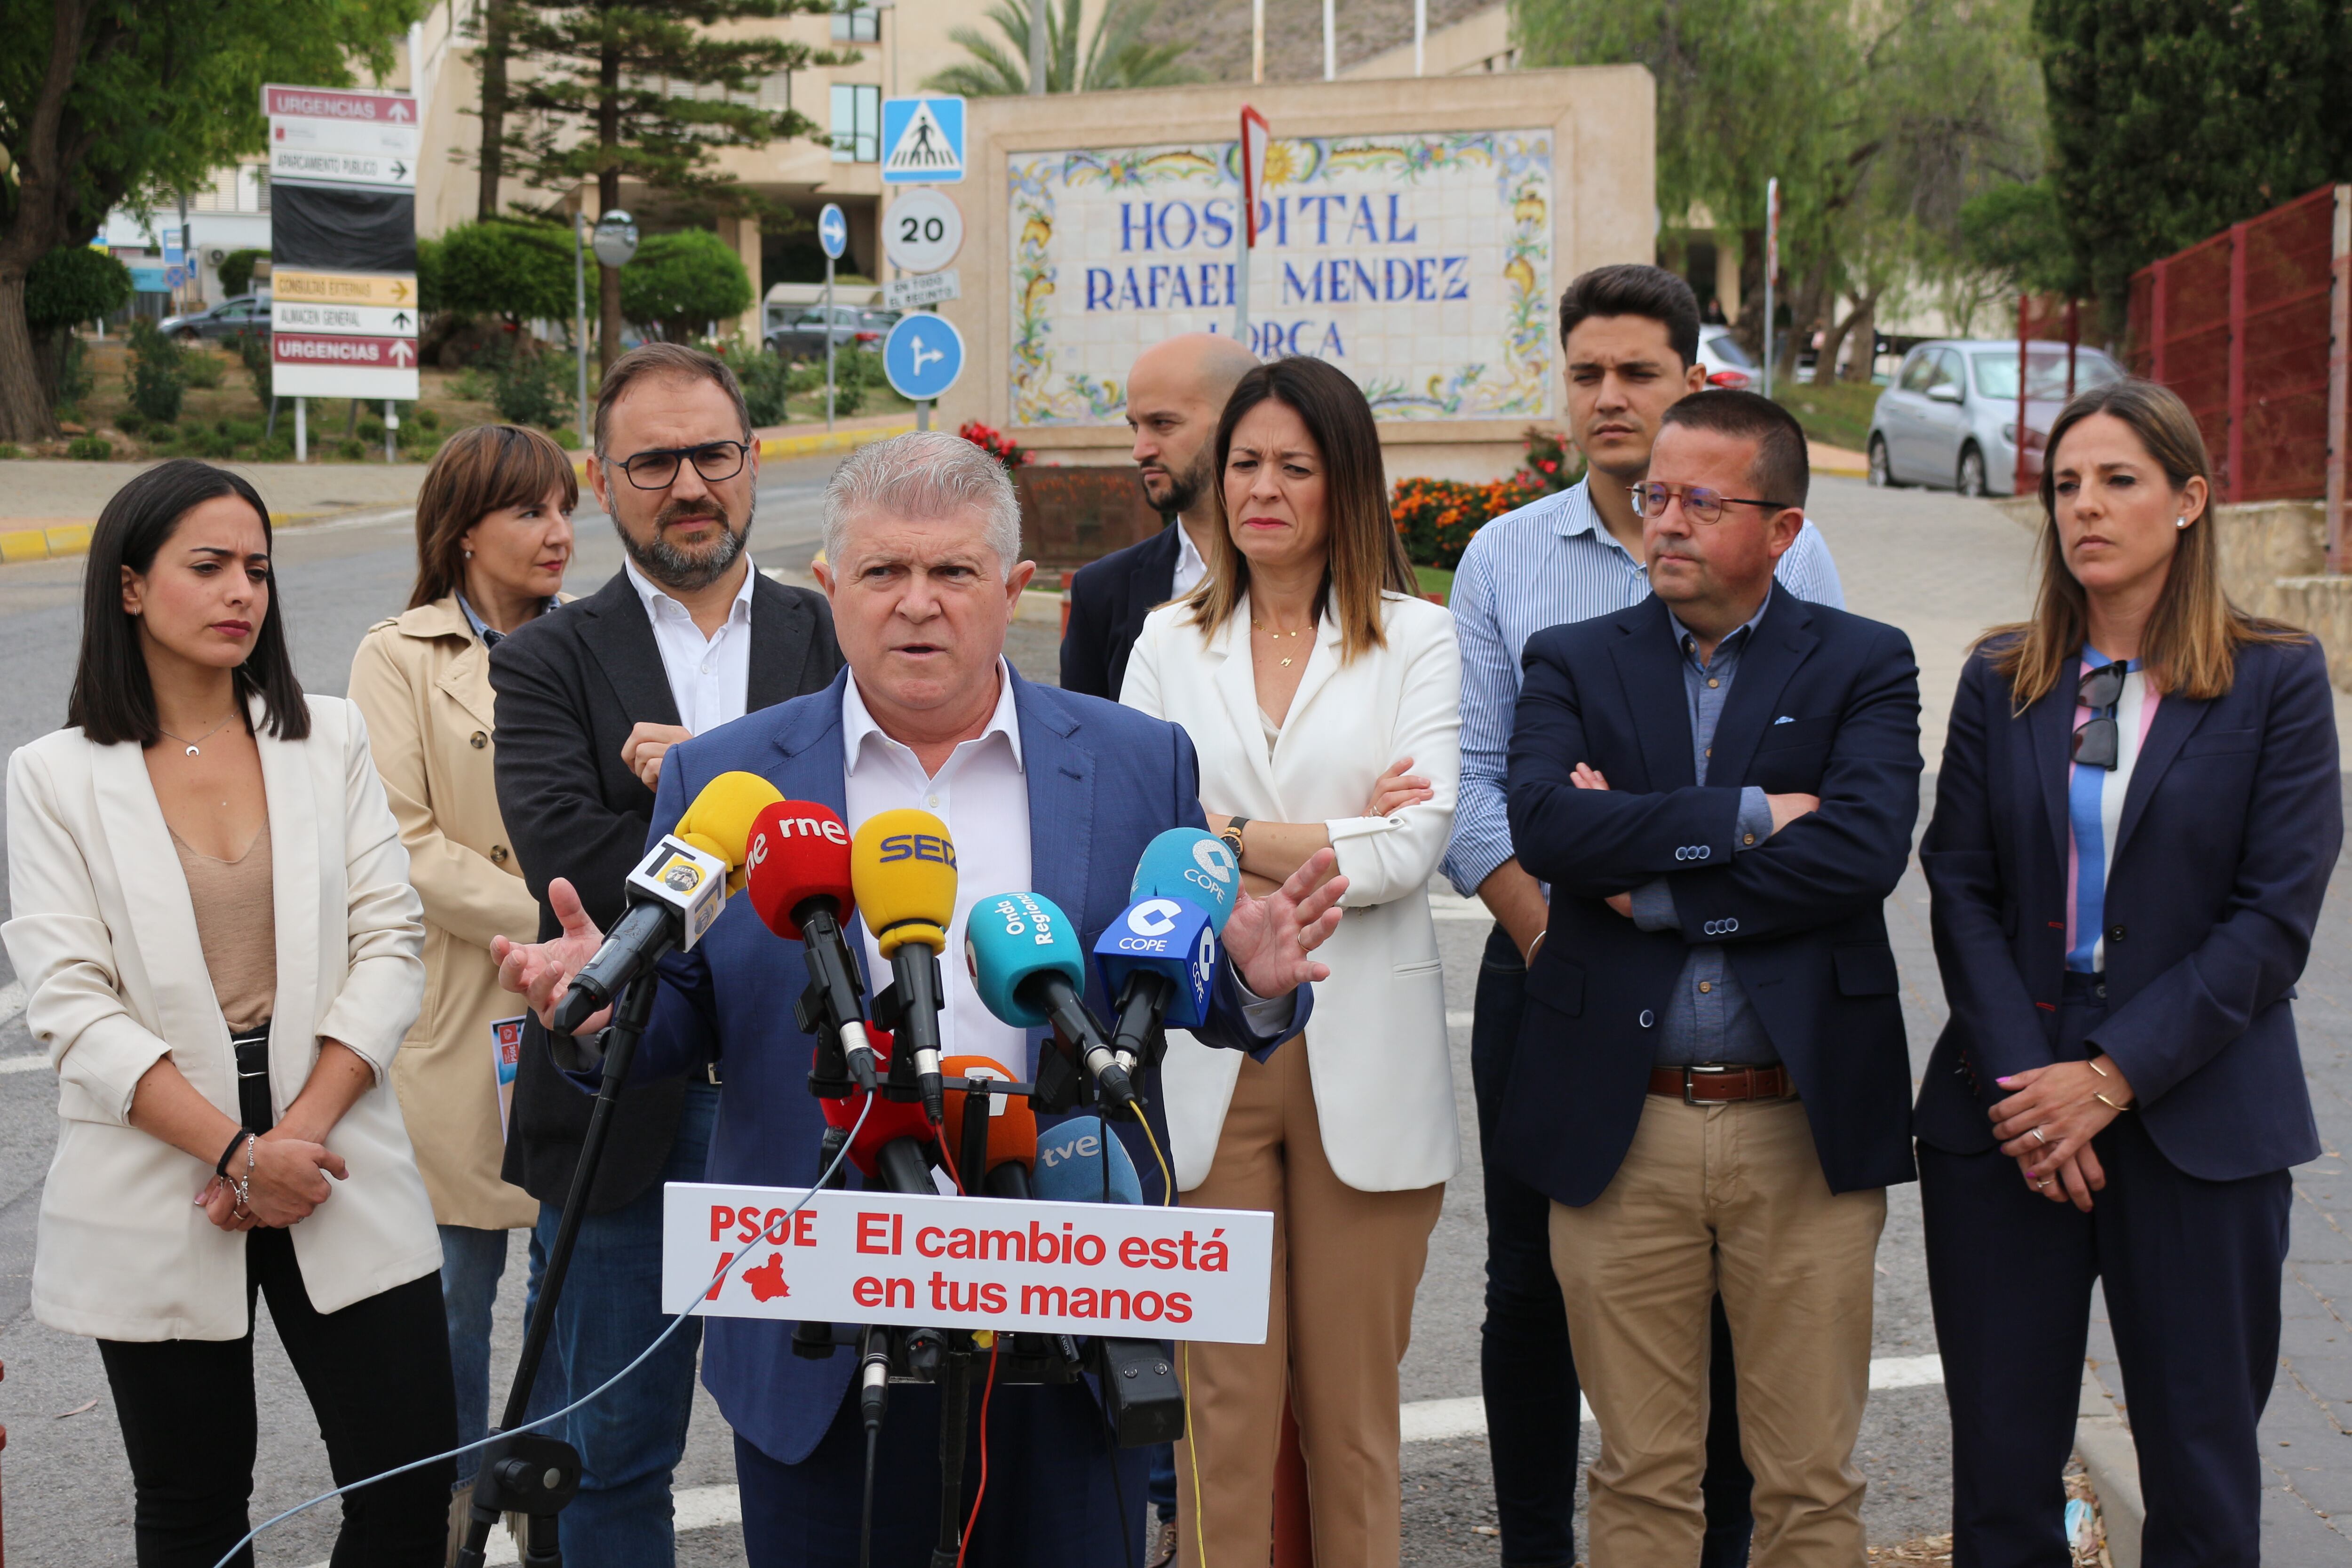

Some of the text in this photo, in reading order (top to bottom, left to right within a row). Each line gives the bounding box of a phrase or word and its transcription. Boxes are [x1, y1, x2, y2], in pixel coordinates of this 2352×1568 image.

[277, 96, 376, 118] URGENCIAS
[901, 218, 943, 242] 20
[1283, 256, 1469, 304] MENDEZ
[278, 339, 380, 361] URGENCIAS
[1209, 321, 1344, 358] RCA
[779, 818, 848, 845] rne
[745, 832, 768, 893] ne
[1184, 868, 1225, 905] COPE
[994, 900, 1025, 935] Onda
[1007, 893, 1054, 945] Regional
[1119, 937, 1168, 952] COPE
[1192, 961, 1204, 1004] COPE
[1042, 1135, 1100, 1168] tve
[710, 1205, 818, 1247] PSOE
[856, 1212, 1229, 1272] El cambio está
[853, 1272, 1192, 1323] en tus manos
[1060, 1335, 1071, 1355] SONY
